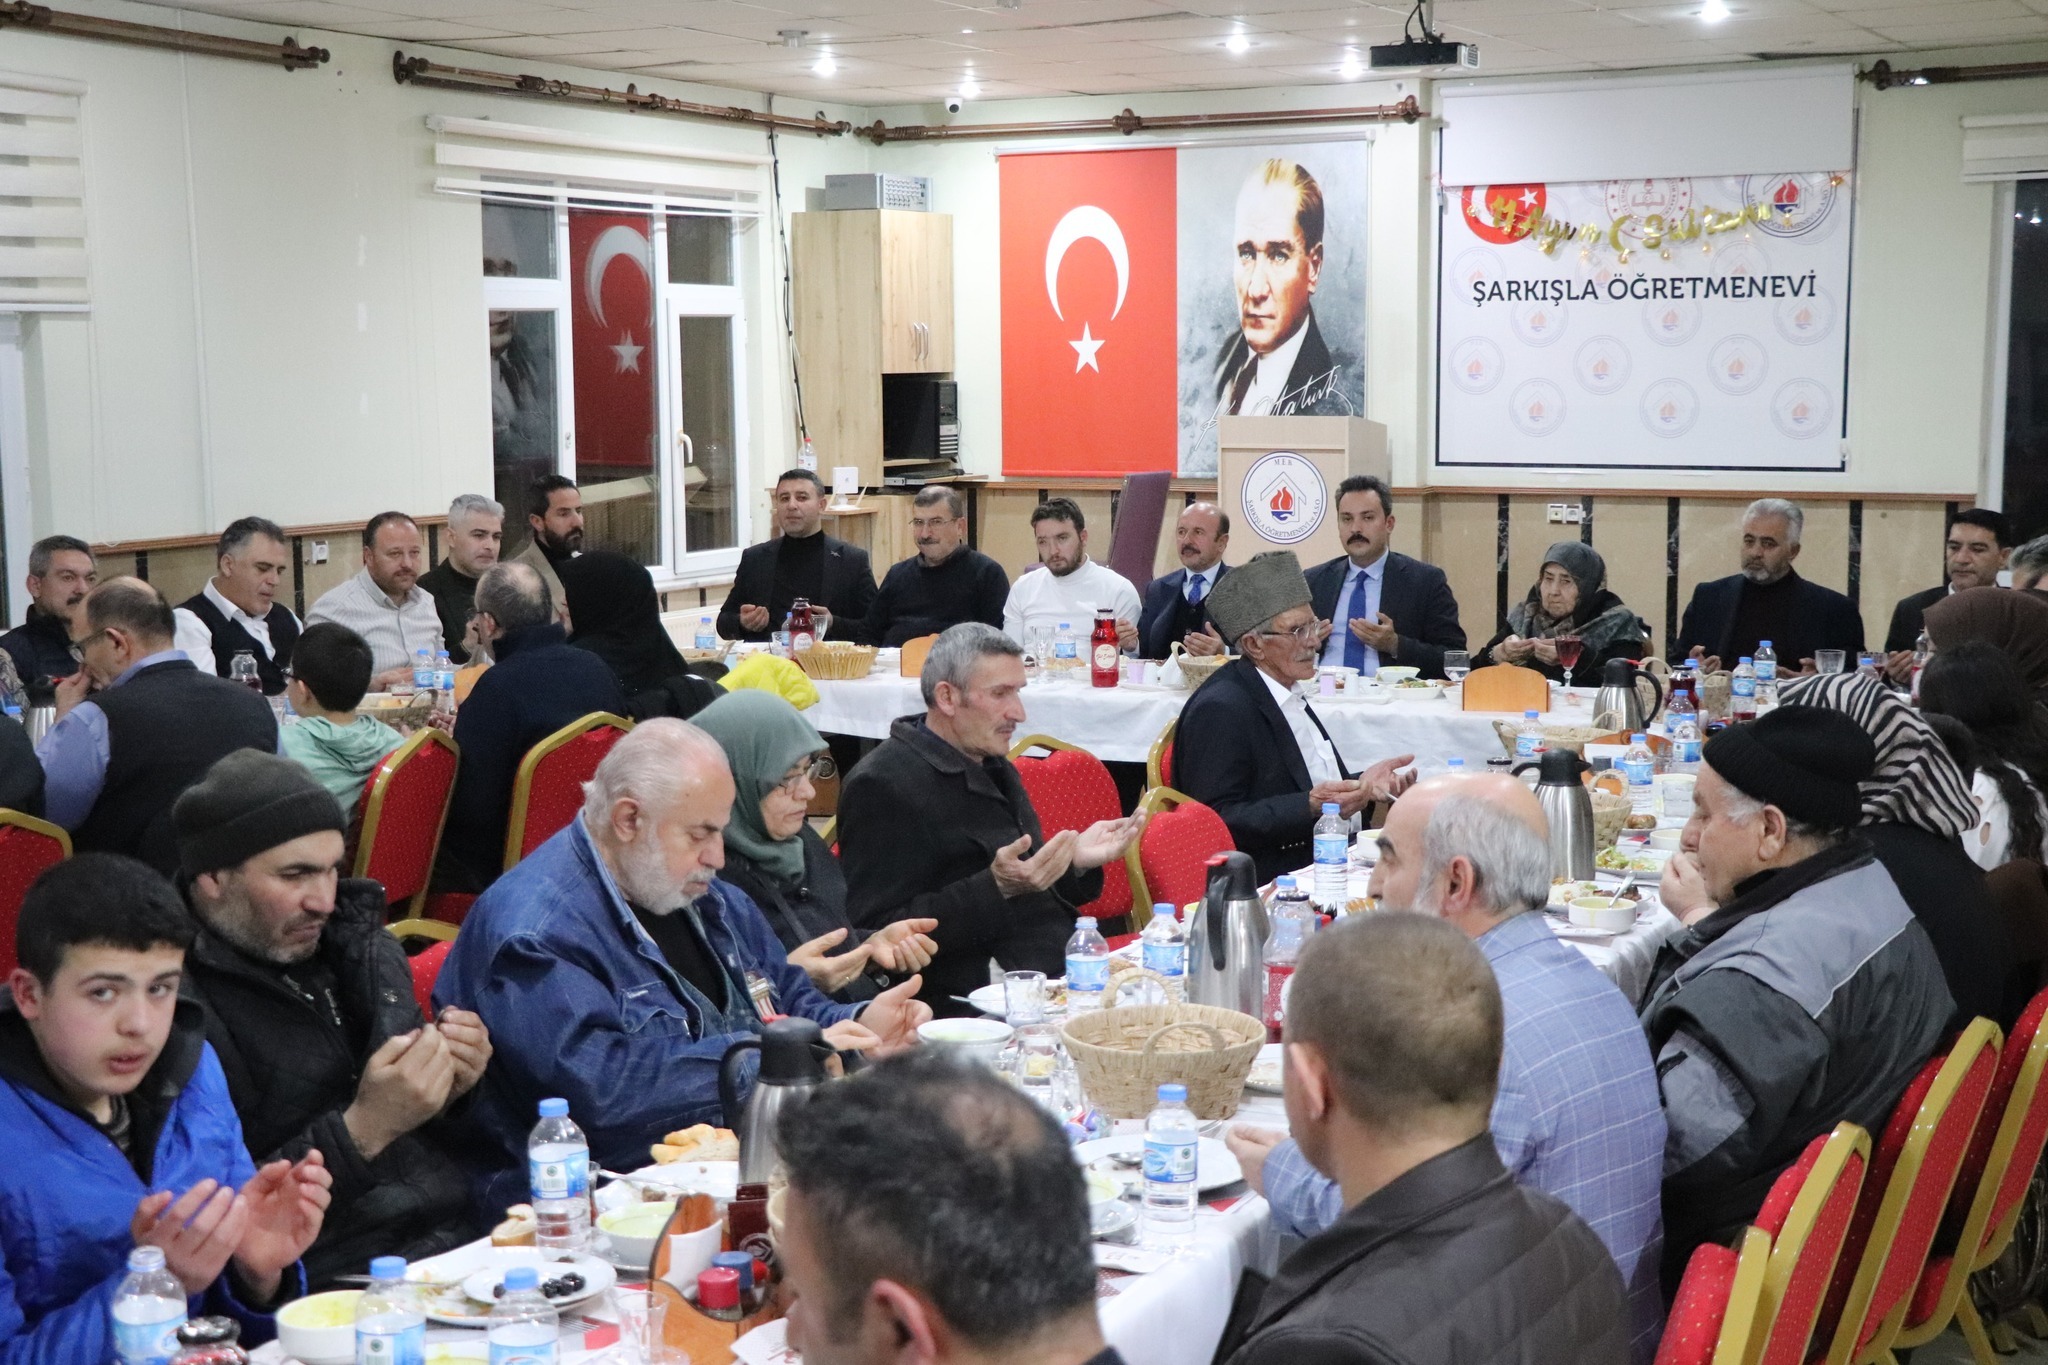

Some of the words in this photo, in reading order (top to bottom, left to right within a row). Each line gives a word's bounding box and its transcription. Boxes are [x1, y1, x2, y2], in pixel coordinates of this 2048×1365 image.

[1473, 279, 1599, 307] ŞARKIŞLA
[1607, 269, 1817, 301] ÖĞRETMENEVİ
[1247, 499, 1265, 529] ŞARKIŞLA
[1265, 520, 1311, 538] ÖĞRETMENEVİ
